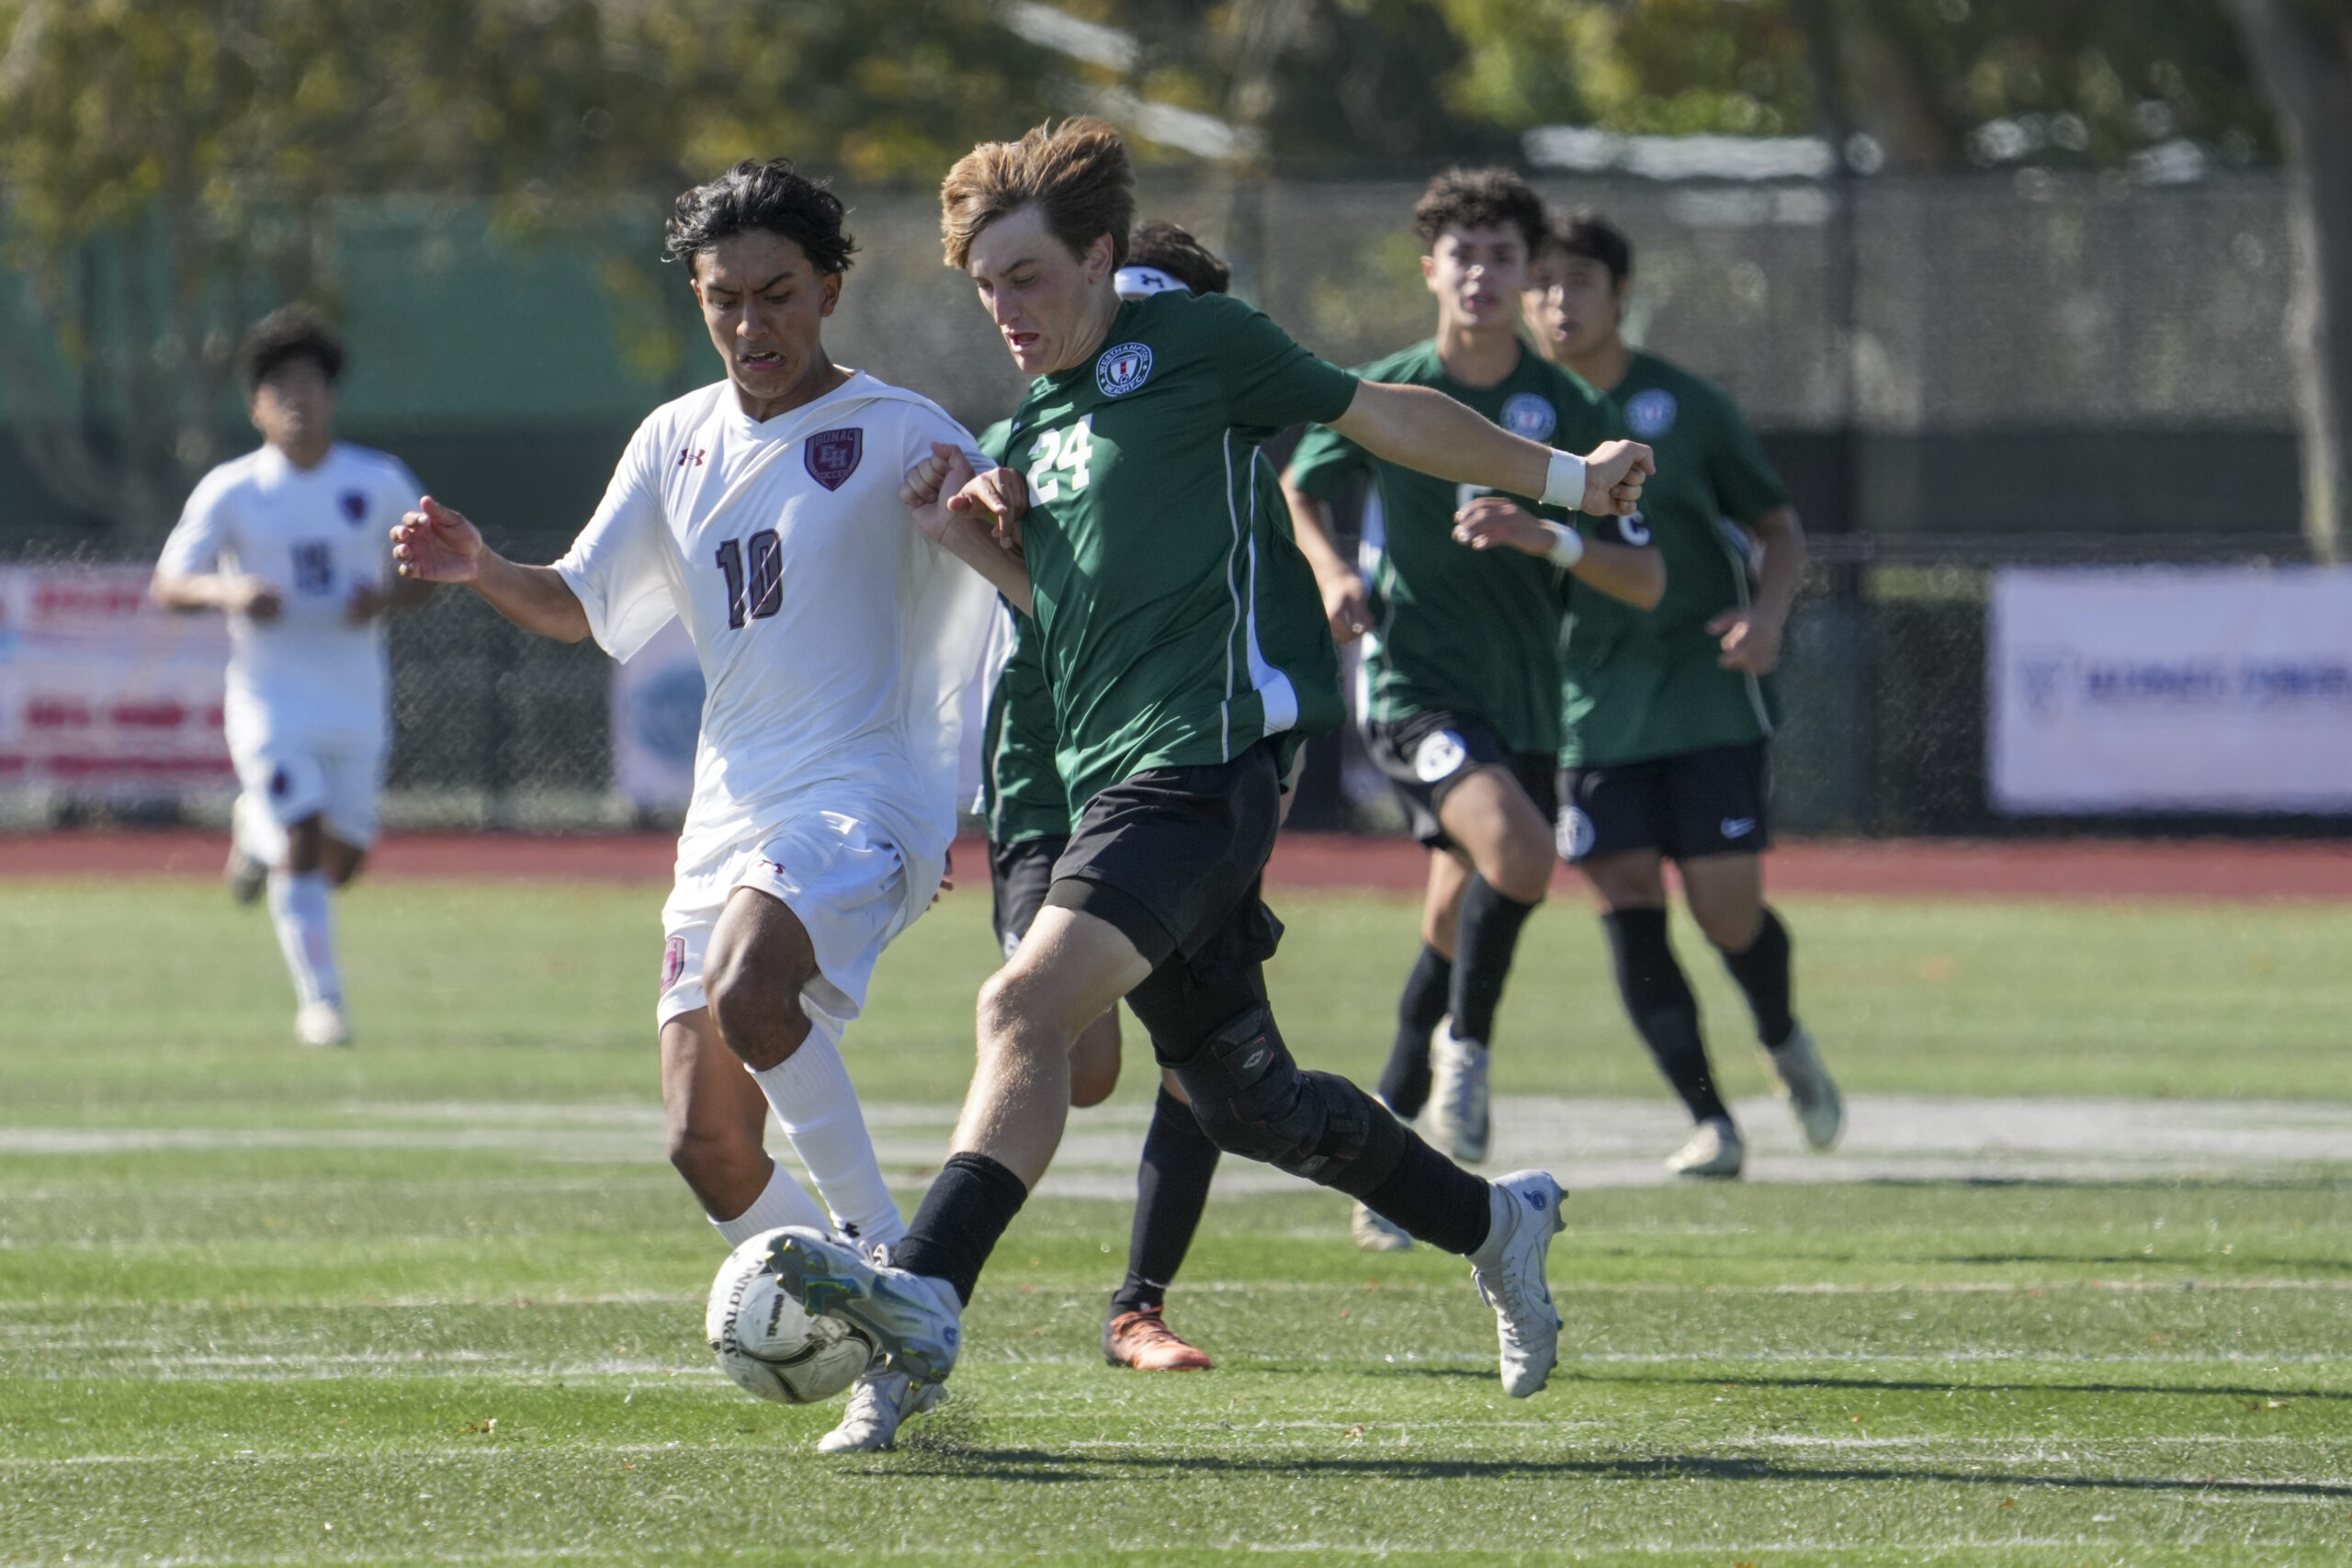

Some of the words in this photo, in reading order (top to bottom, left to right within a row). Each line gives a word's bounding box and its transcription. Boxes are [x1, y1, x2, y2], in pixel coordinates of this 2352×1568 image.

[1100, 344, 1149, 375] WESTHAMPTON
[1103, 384, 1130, 395] BEACH
[815, 430, 854, 446] BONAC
[1026, 412, 1093, 508] 24
[816, 468, 849, 479] SOCCER
[715, 528, 783, 630] 10
